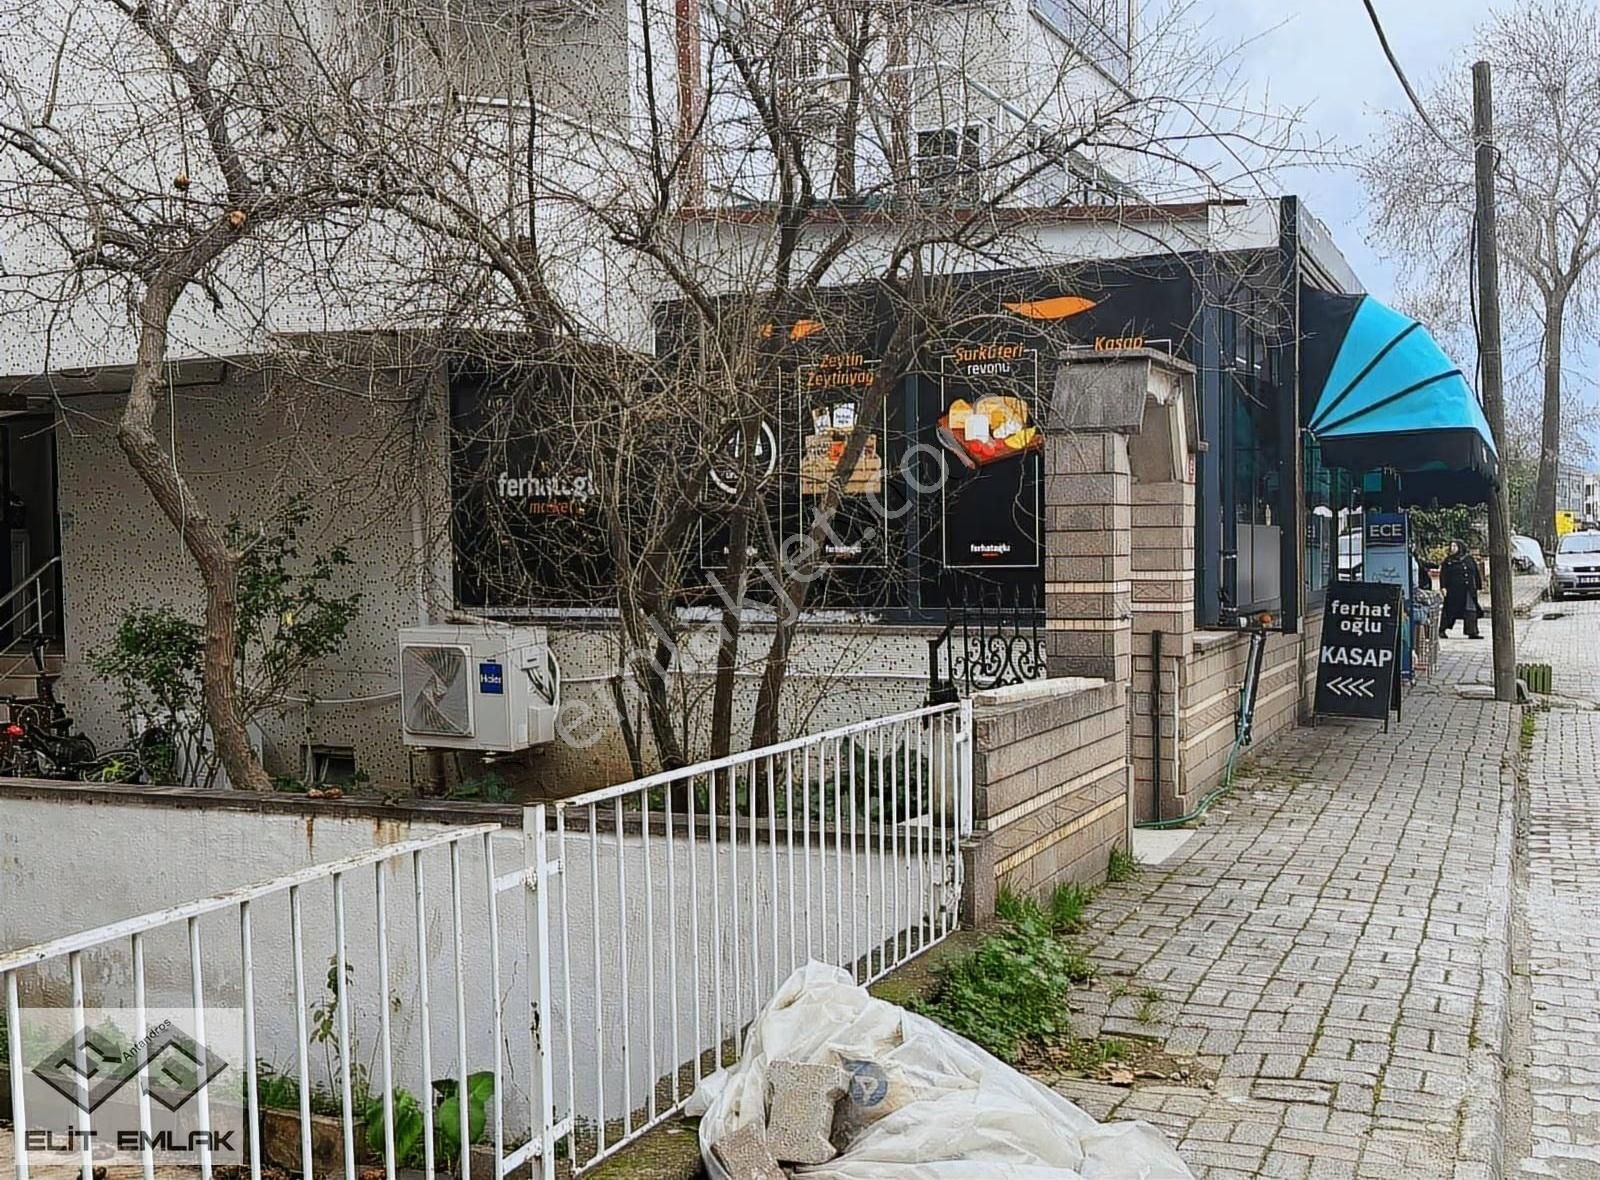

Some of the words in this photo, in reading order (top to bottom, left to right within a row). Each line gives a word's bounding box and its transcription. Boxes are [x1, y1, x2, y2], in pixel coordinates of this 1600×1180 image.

[1369, 523, 1403, 537] ECE
[1331, 599, 1391, 617] ferhat
[1340, 617, 1381, 636] oğlu
[1321, 645, 1392, 667] KASAP
[480, 673, 502, 684] Haier
